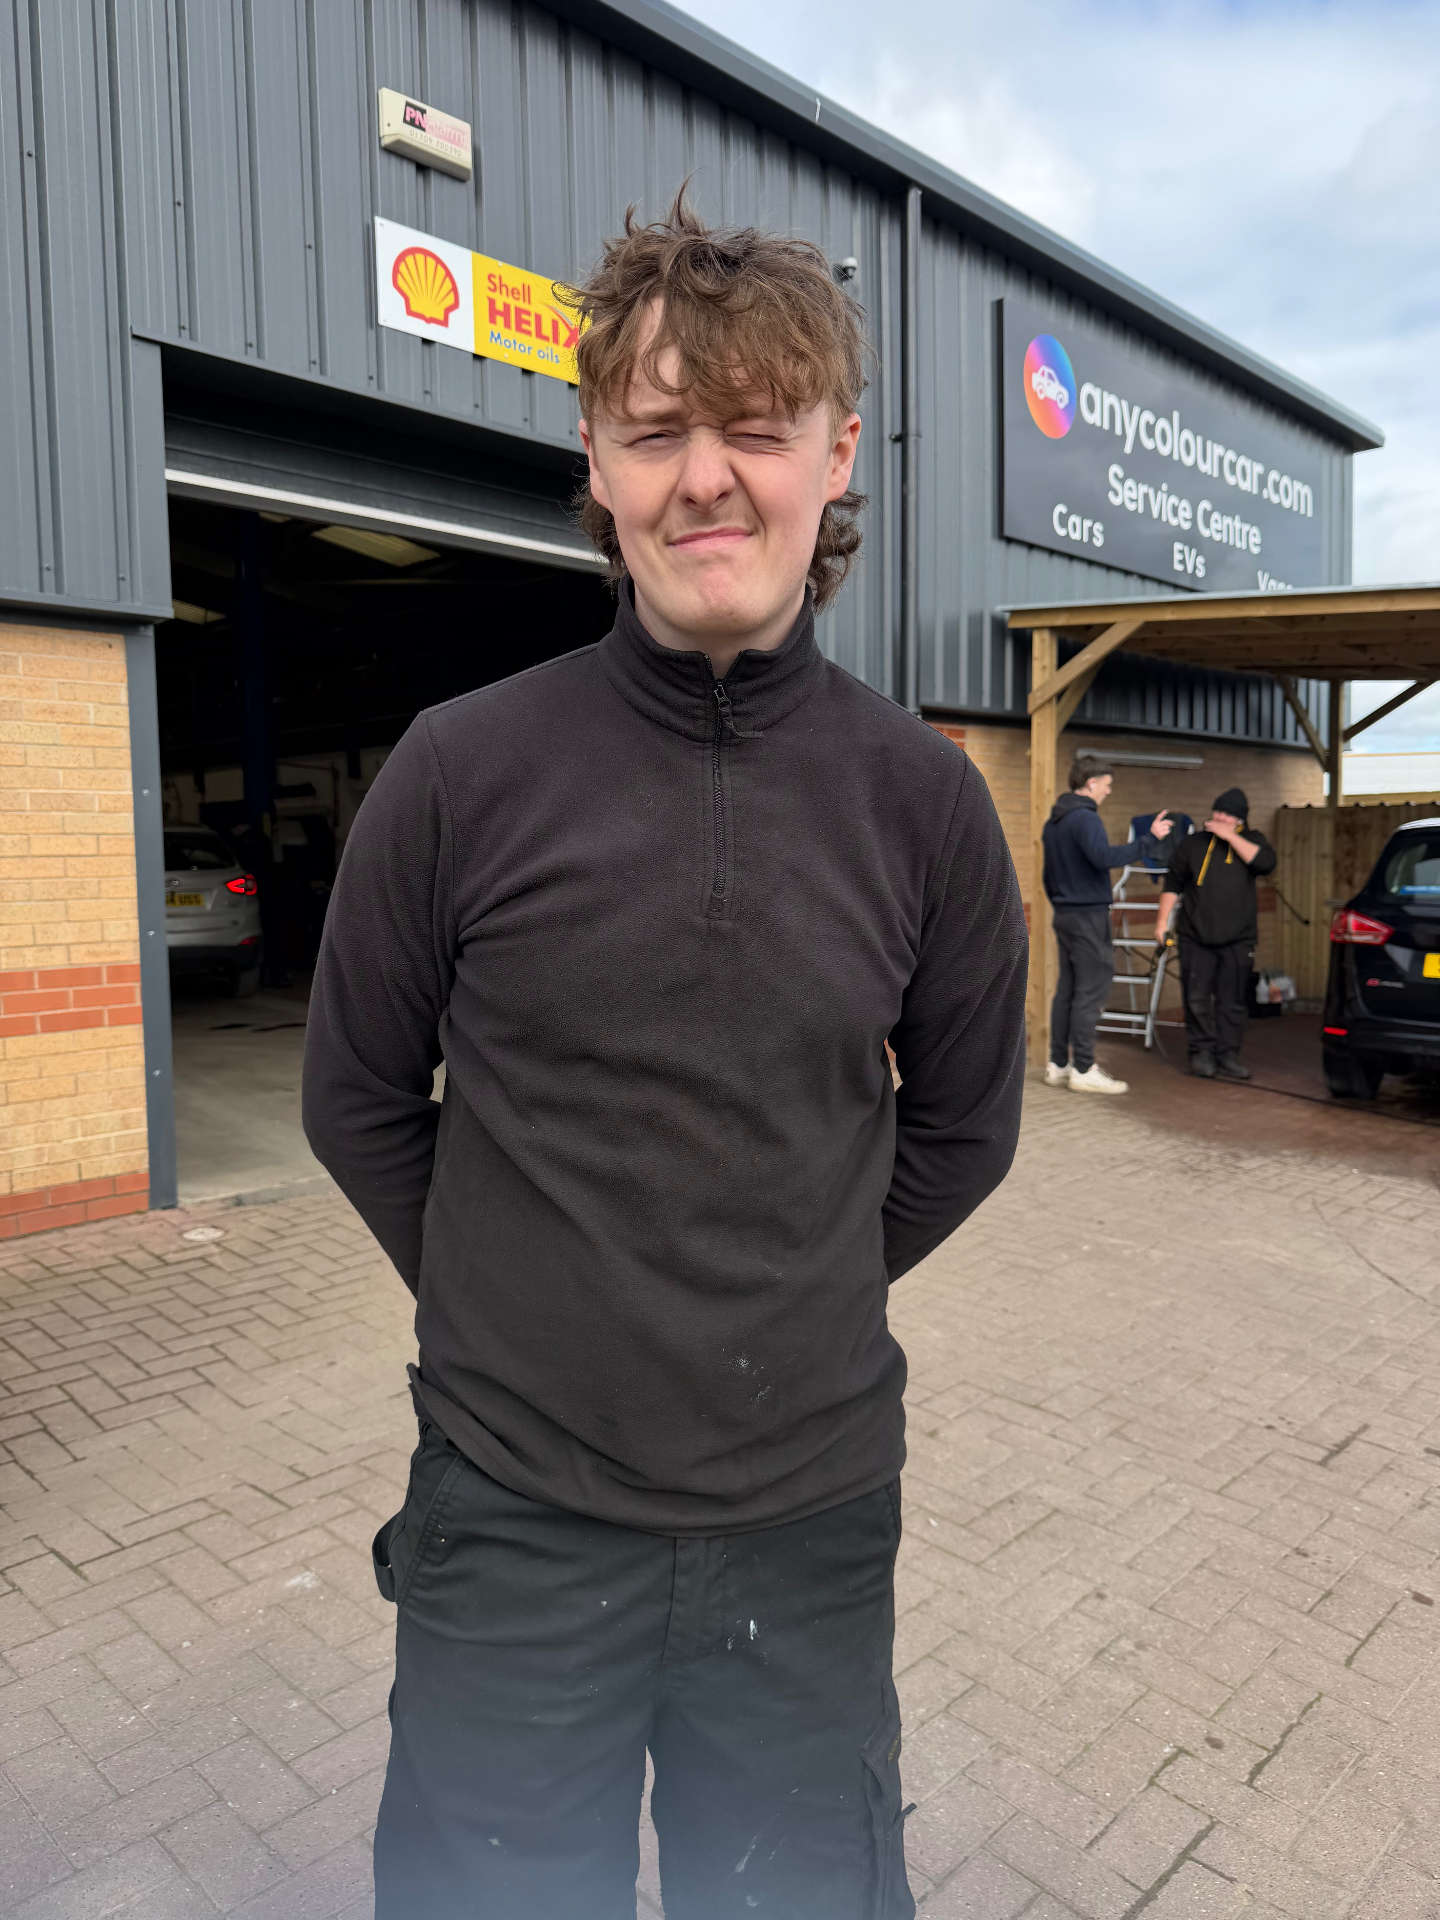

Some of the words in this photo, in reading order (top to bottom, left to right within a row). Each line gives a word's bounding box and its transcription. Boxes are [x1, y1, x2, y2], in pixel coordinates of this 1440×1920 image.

[405, 106, 428, 129] PN
[487, 273, 531, 305] Shell
[487, 296, 580, 349] HELIX
[489, 330, 533, 355] Motor
[537, 347, 560, 364] oils
[1079, 381, 1314, 518] anycolourcar.com
[1052, 503, 1105, 547] Cars
[1108, 463, 1193, 530] Service
[1197, 499, 1262, 555] Centre
[1173, 541, 1206, 578] EVs
